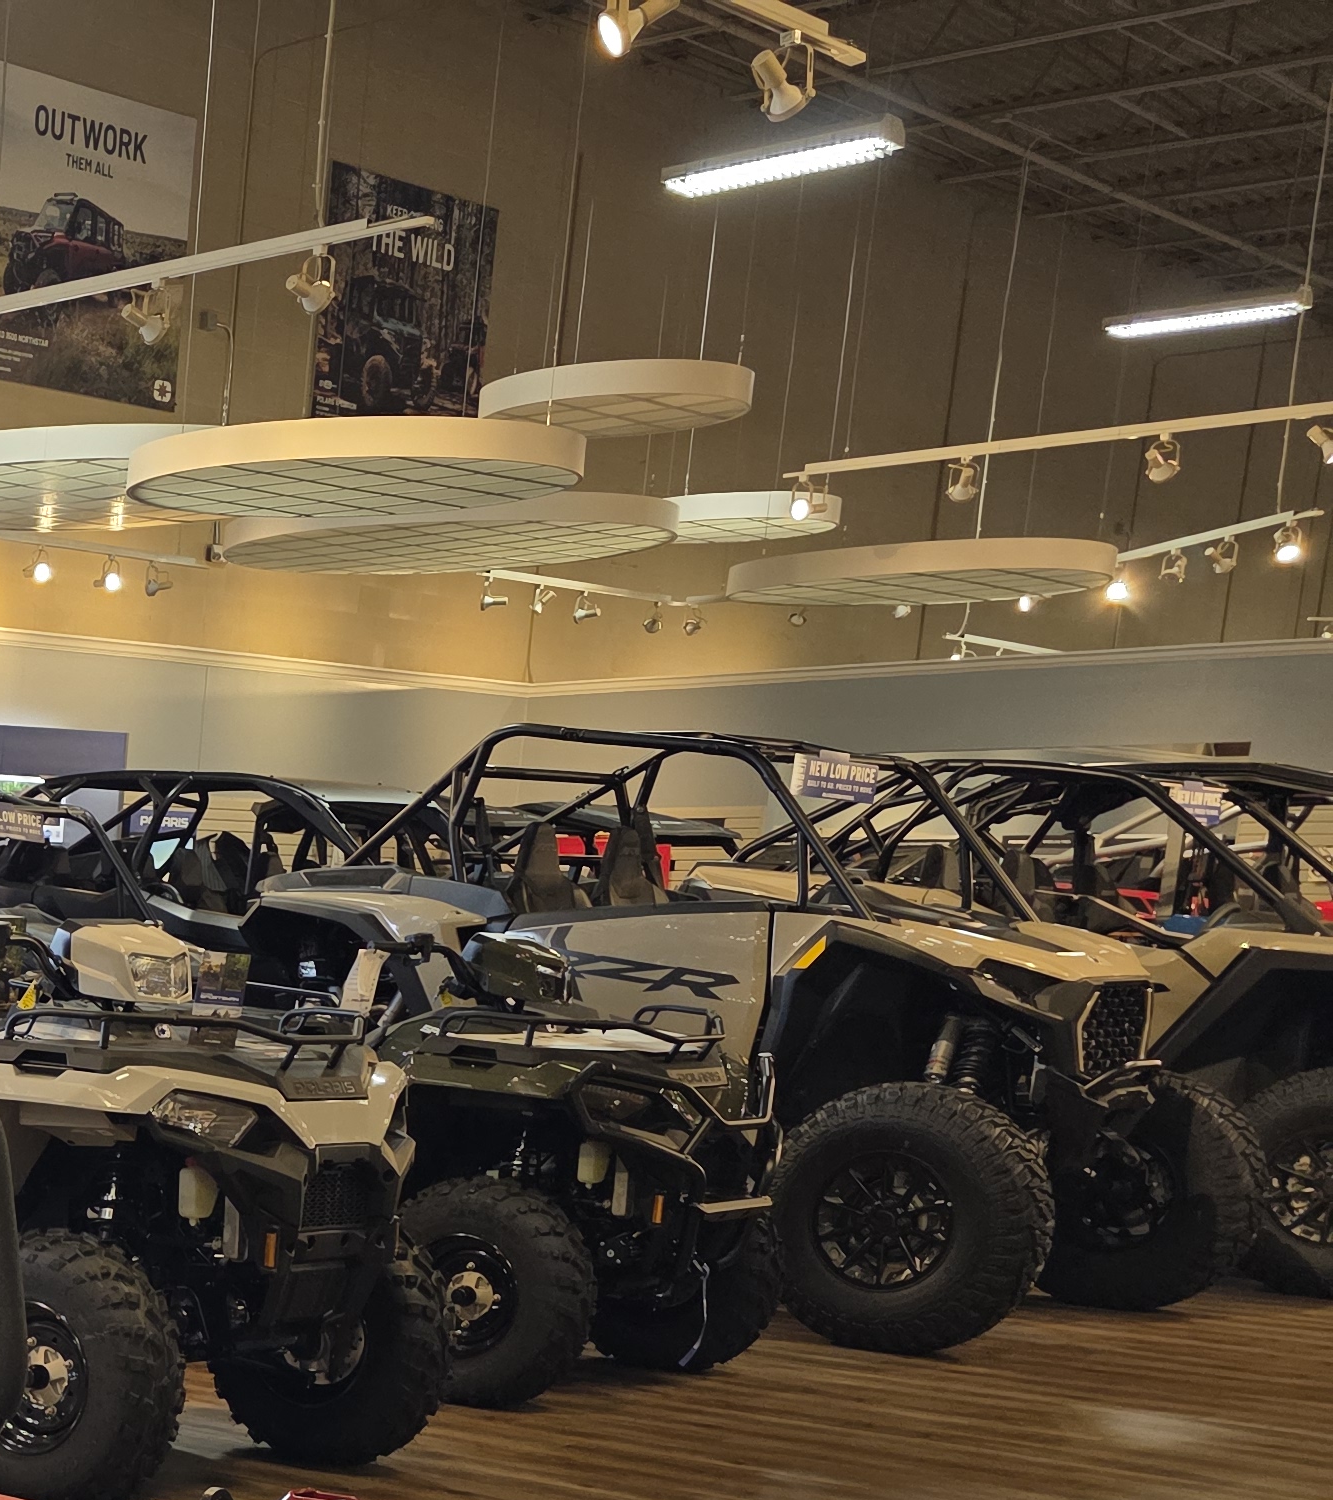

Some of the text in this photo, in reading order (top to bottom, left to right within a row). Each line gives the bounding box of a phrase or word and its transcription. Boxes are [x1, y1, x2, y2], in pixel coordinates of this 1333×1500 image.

[35, 104, 148, 165] OUTWORK
[65, 153, 114, 179] THEM ALL
[372, 229, 455, 272] THE WILD
[808, 760, 830, 778] NEW
[829, 763, 850, 780] LOW
[850, 765, 877, 784] PRICE
[17, 812, 42, 828] PRICE
[140, 815, 189, 829] PARIS
